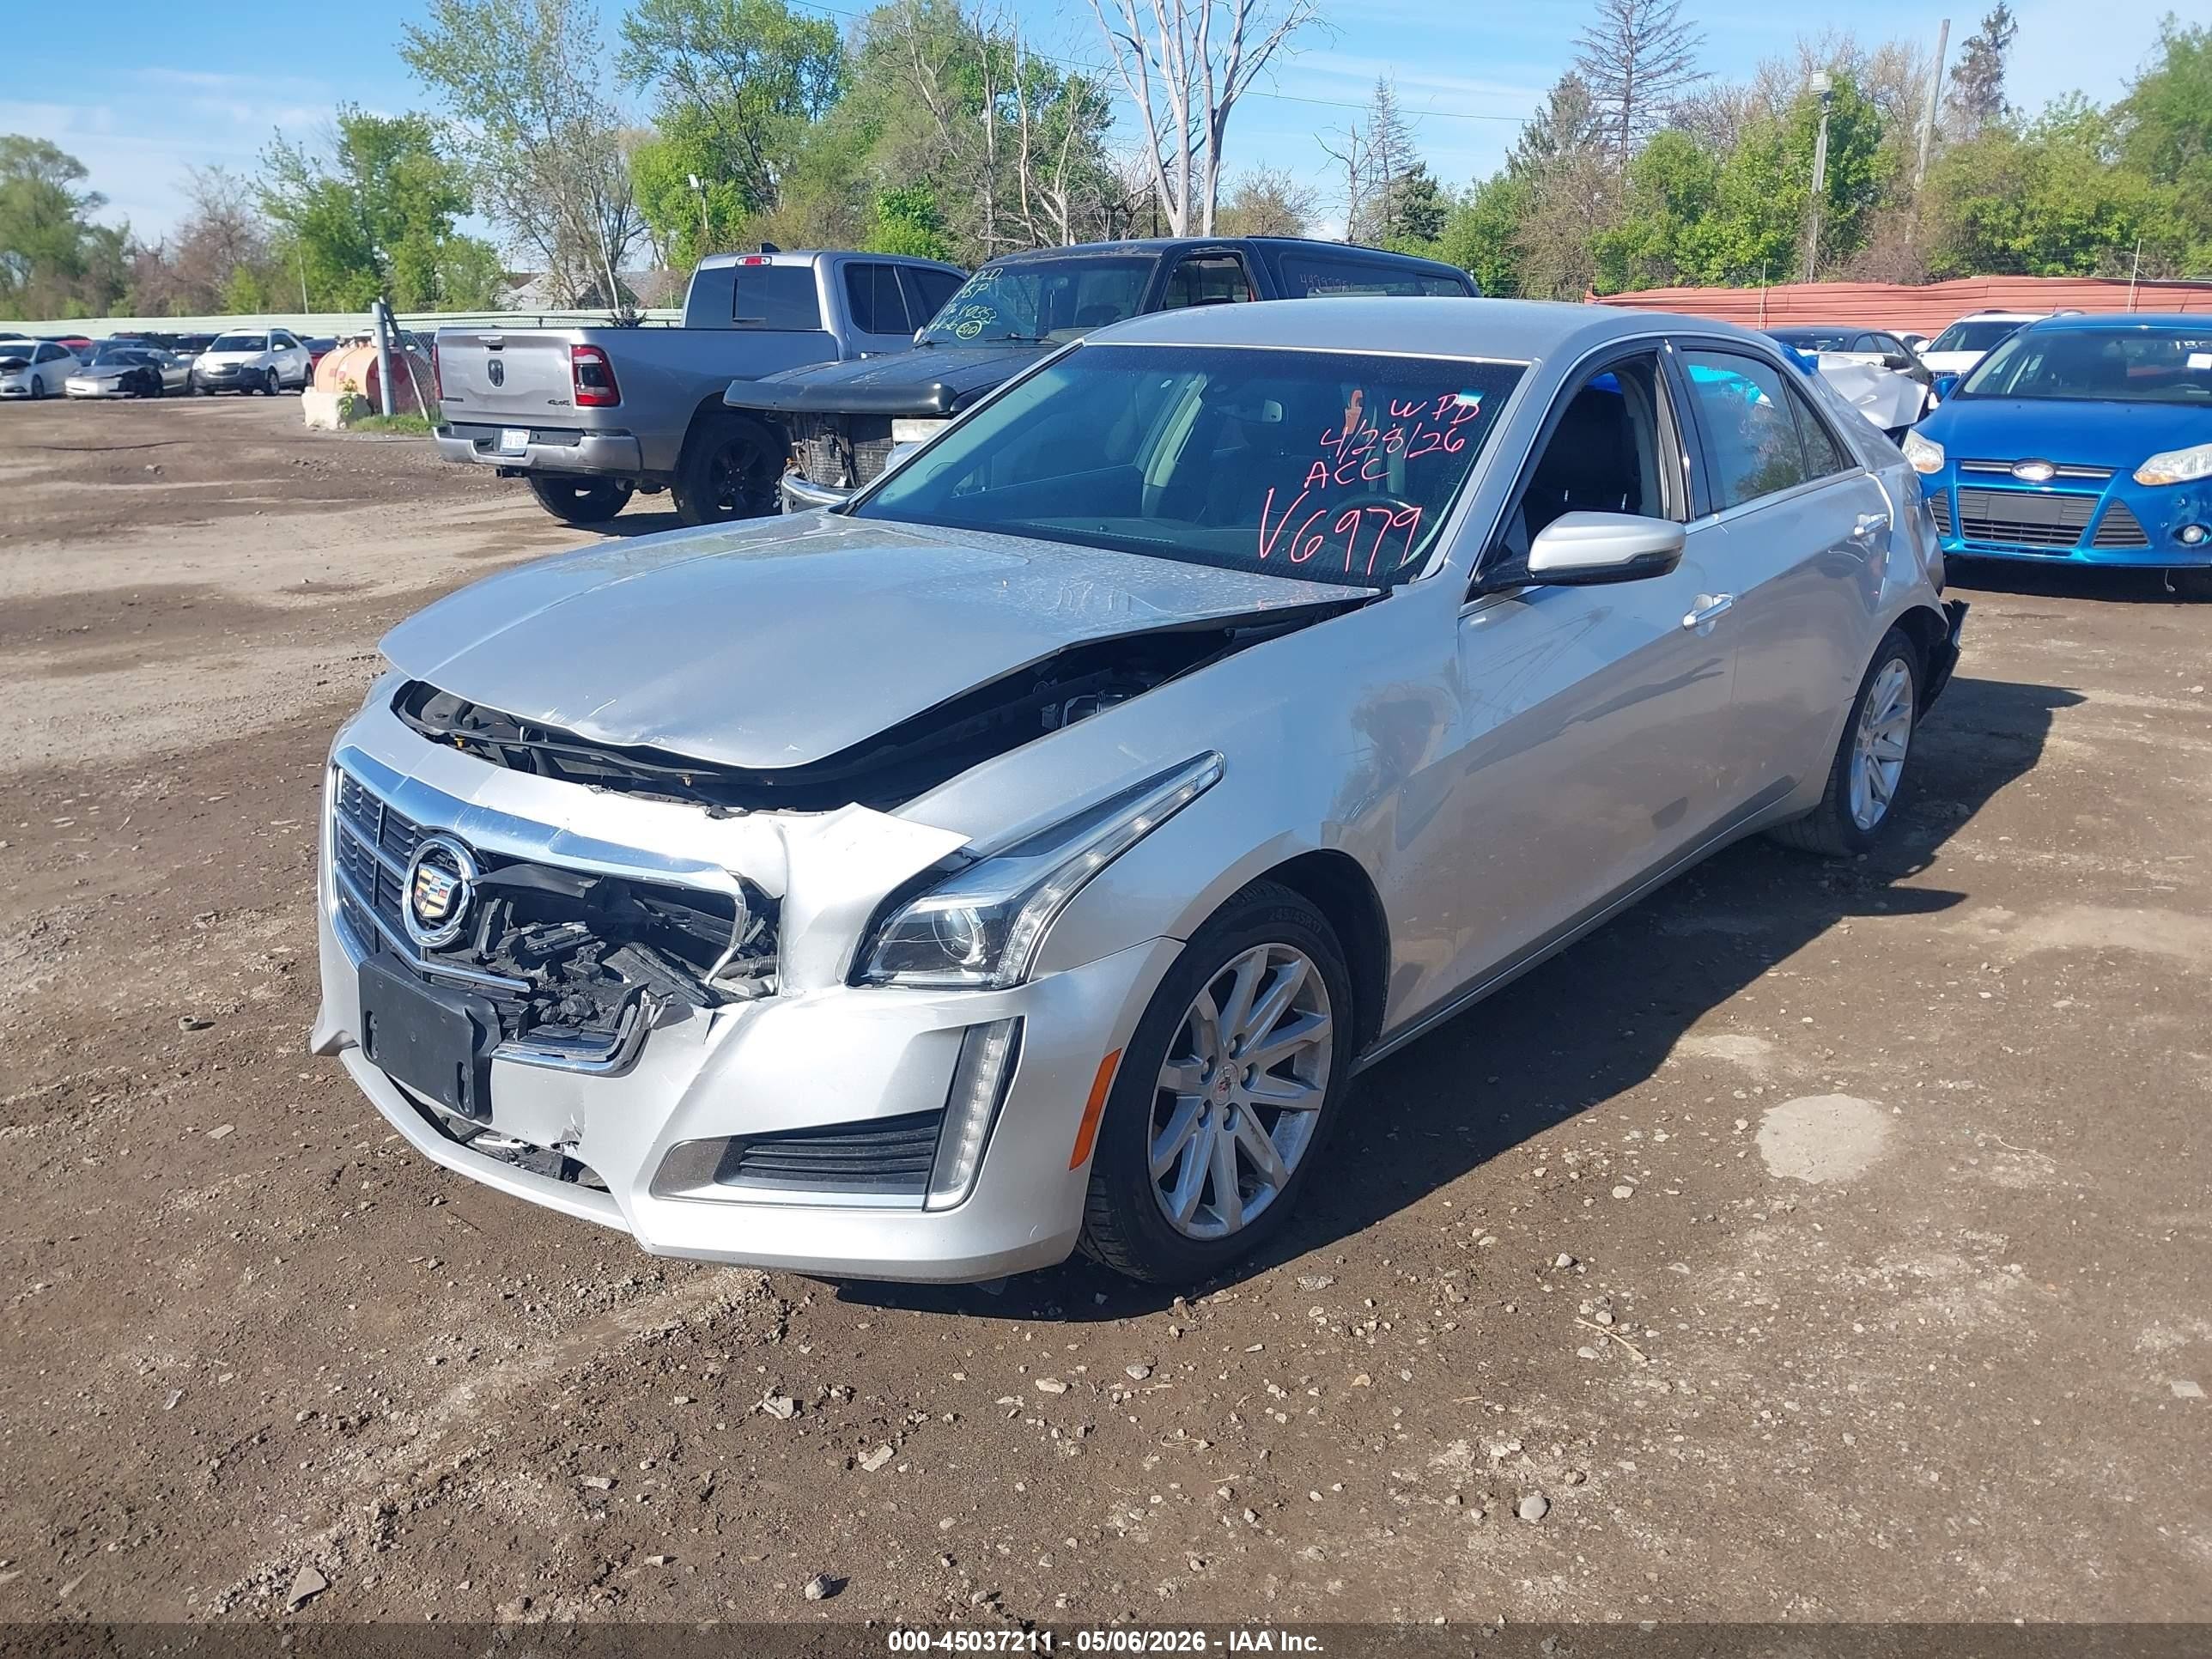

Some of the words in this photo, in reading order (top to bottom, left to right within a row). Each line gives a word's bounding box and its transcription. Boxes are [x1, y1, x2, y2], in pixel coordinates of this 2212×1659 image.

[1320, 418, 1465, 464] 4/28/26
[1304, 458, 1391, 489] ACC
[1259, 487, 1423, 576] V6979
